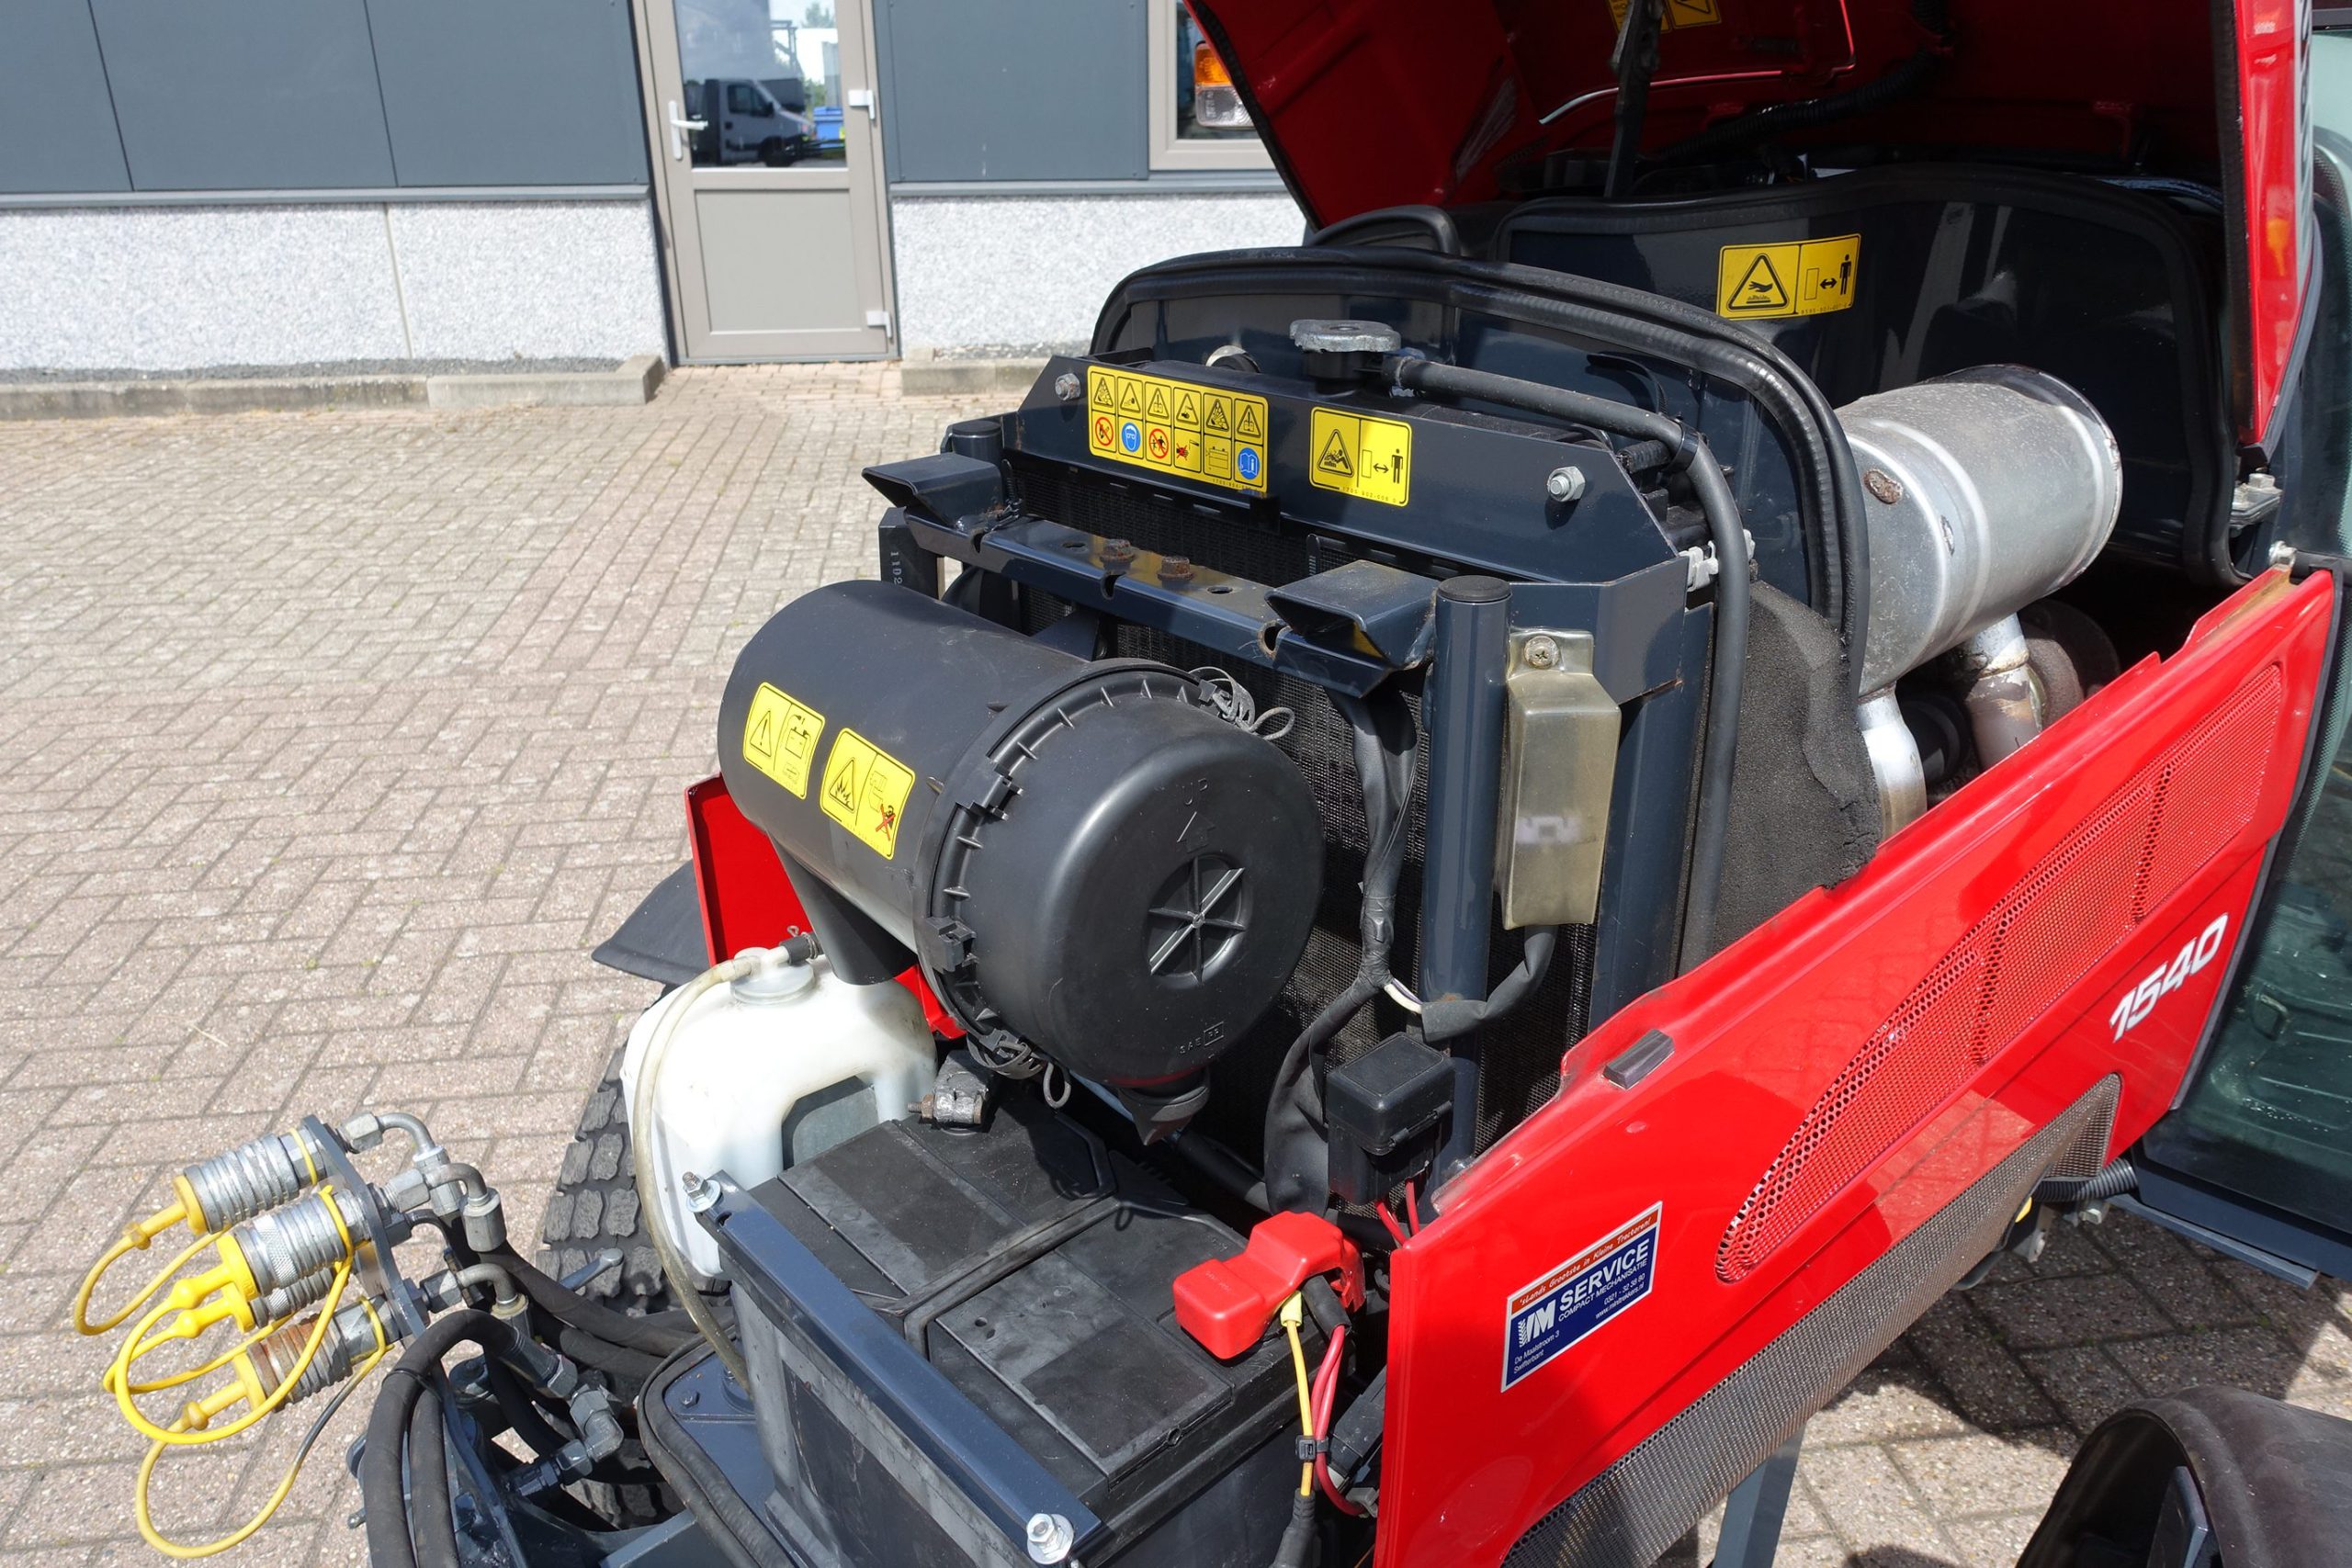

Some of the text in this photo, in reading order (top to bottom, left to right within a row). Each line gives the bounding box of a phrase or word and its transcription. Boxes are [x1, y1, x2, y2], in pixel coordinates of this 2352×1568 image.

[2109, 911, 2229, 1043] 1540
[1558, 1258, 1647, 1322] COMPACT MECHANISATIE
[1559, 1238, 1649, 1314] SERVICE
